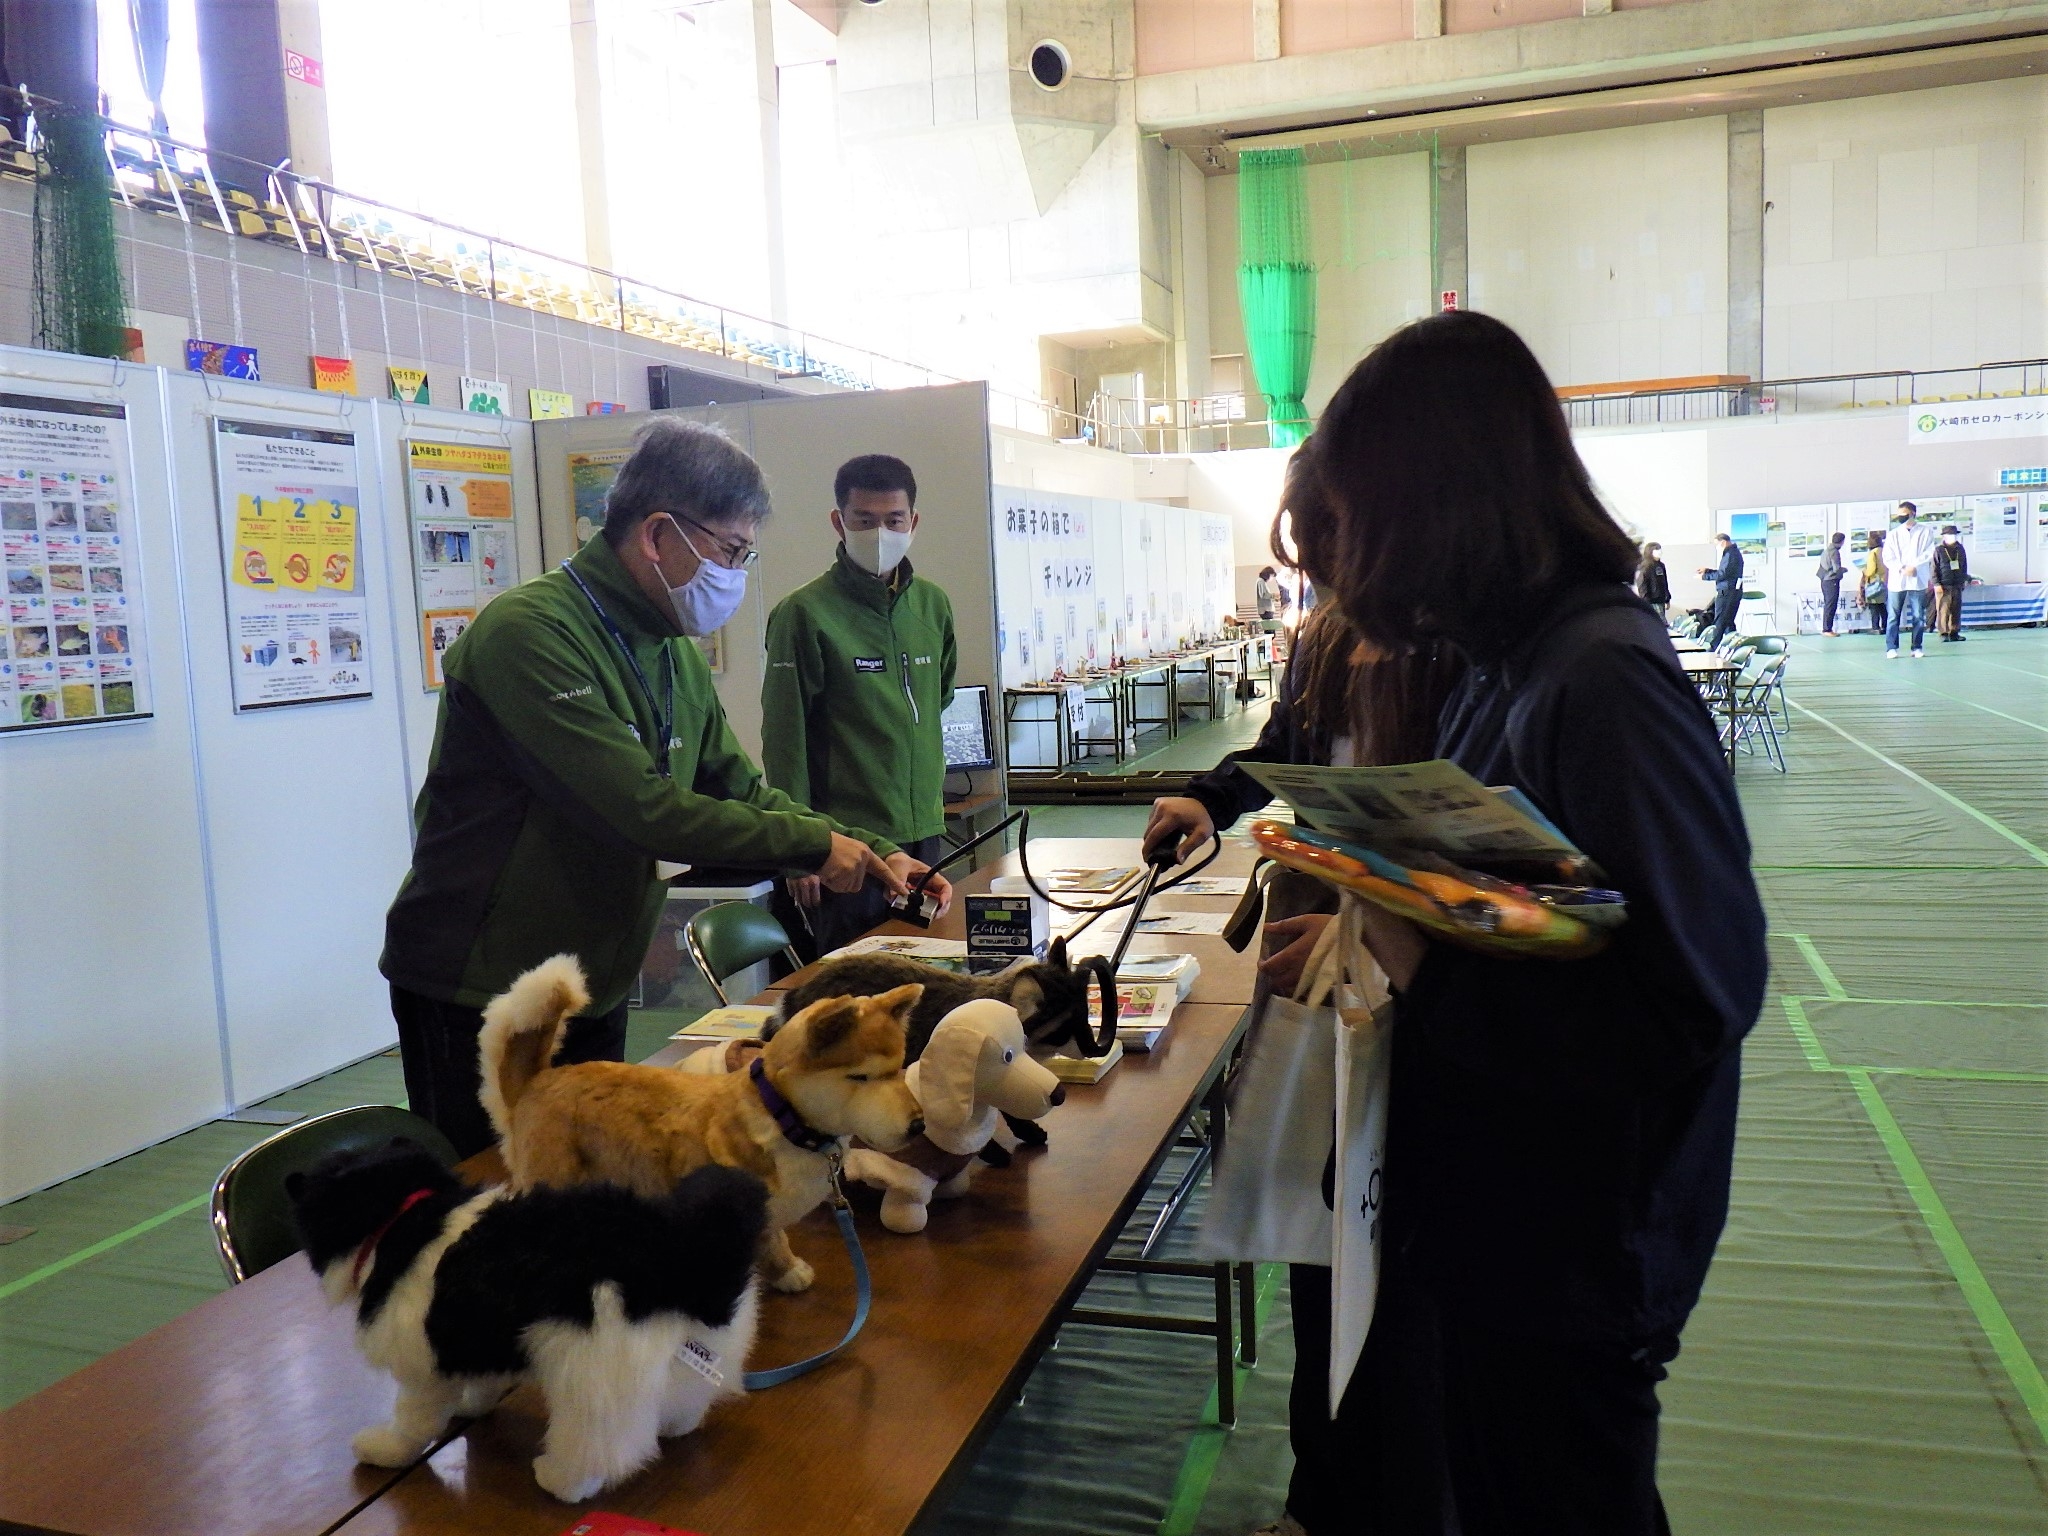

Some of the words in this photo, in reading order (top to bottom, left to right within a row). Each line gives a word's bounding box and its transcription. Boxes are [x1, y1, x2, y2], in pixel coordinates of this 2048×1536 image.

[1938, 411, 2048, 427] 大崎市ゼロカーボンシ
[265, 443, 317, 457] 私たちにできること
[419, 446, 443, 457] 外来生物
[252, 495, 262, 517] 1
[293, 497, 306, 519] 2
[330, 499, 342, 519] 3
[1007, 505, 1070, 536] お菓子の箱で
[1044, 564, 1092, 590] チャレンジ
[855, 658, 884, 669] Ranger
